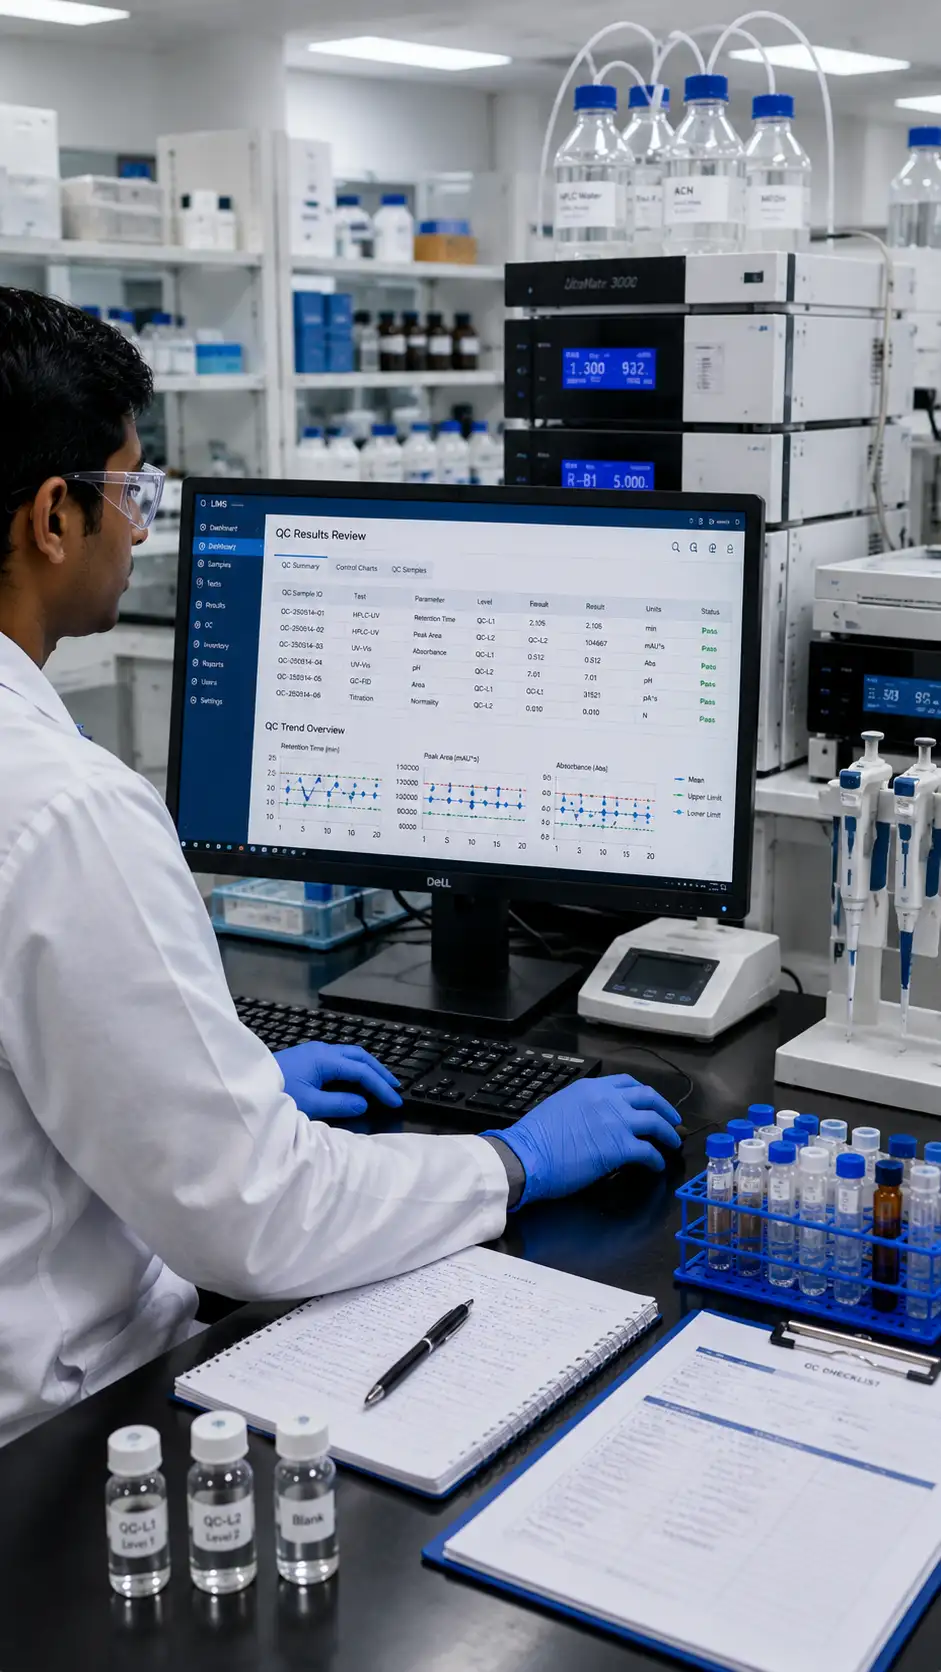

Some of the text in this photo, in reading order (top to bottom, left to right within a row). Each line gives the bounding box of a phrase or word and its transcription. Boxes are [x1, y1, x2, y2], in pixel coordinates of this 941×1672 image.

[675, 187, 693, 195] ACN
[610, 277, 638, 289] 3000
[210, 500, 227, 508] LIMS
[276, 528, 366, 540] QC Results Review
[293, 562, 320, 571] Summary
[293, 590, 315, 598] Sample
[354, 592, 367, 600] Test
[413, 648, 447, 656] Absorbance
[411, 698, 439, 707] Normality
[265, 722, 345, 734] QC Trend Overview
[281, 742, 308, 751] Retention
[424, 752, 438, 760] Peak
[556, 762, 591, 771] Absorbance
[688, 793, 705, 801] Upper
[203, 1513, 242, 1529] QC-L2
[292, 1513, 324, 1526] Blank
[119, 1519, 156, 1535] QC-L1
[206, 1531, 232, 1542] Level
[122, 1538, 147, 1550] Level
